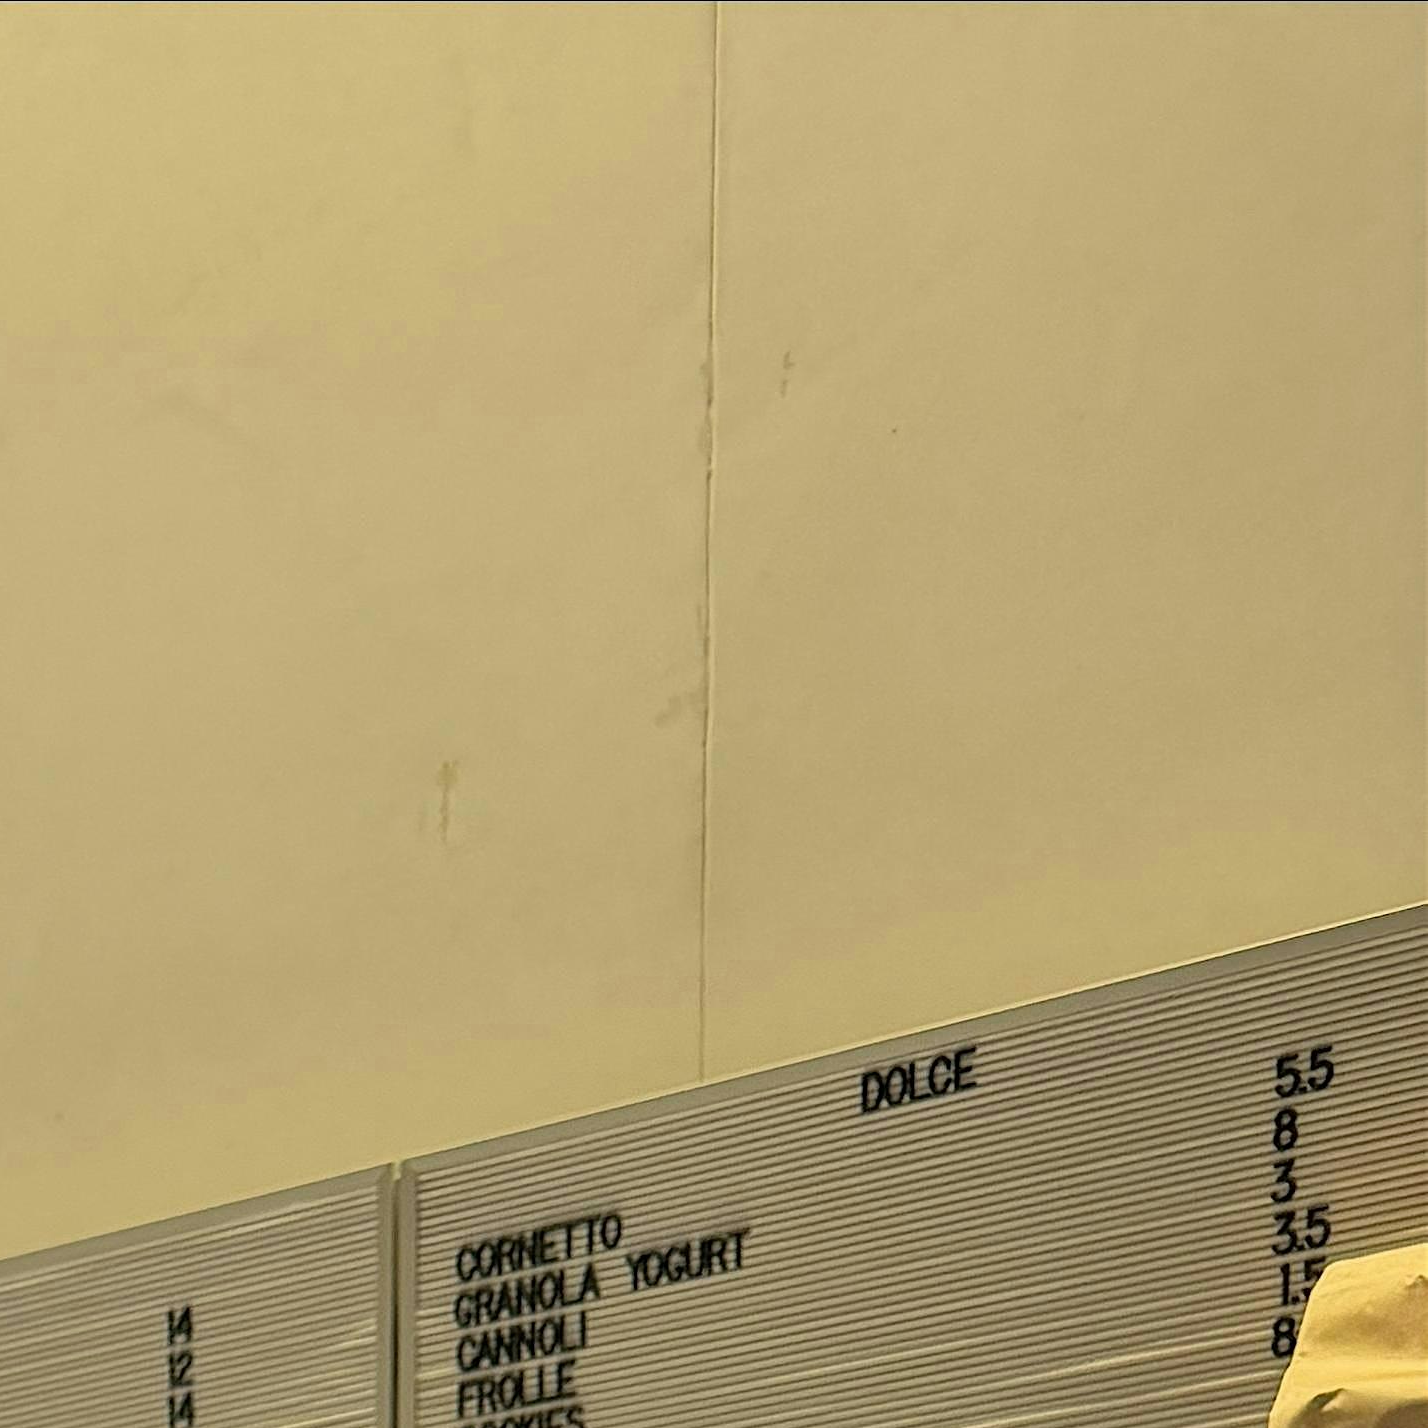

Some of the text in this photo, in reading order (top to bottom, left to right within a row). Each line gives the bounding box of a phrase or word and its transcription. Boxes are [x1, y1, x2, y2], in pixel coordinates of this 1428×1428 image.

[859, 1045, 977, 1114] DOLCE
[1275, 1046, 1334, 1098] 5.5
[1273, 1108, 1298, 1151] 8
[1271, 1158, 1296, 1203] 3
[456, 1213, 622, 1281] CORNETTO
[1272, 1204, 1331, 1255] 3.5
[454, 1229, 745, 1329] GRANOLA YOGURT
[166, 1305, 193, 1346] 14
[456, 1318, 588, 1373] CANNOLI
[166, 1352, 193, 1388] 12
[457, 1361, 578, 1418] FROLLE
